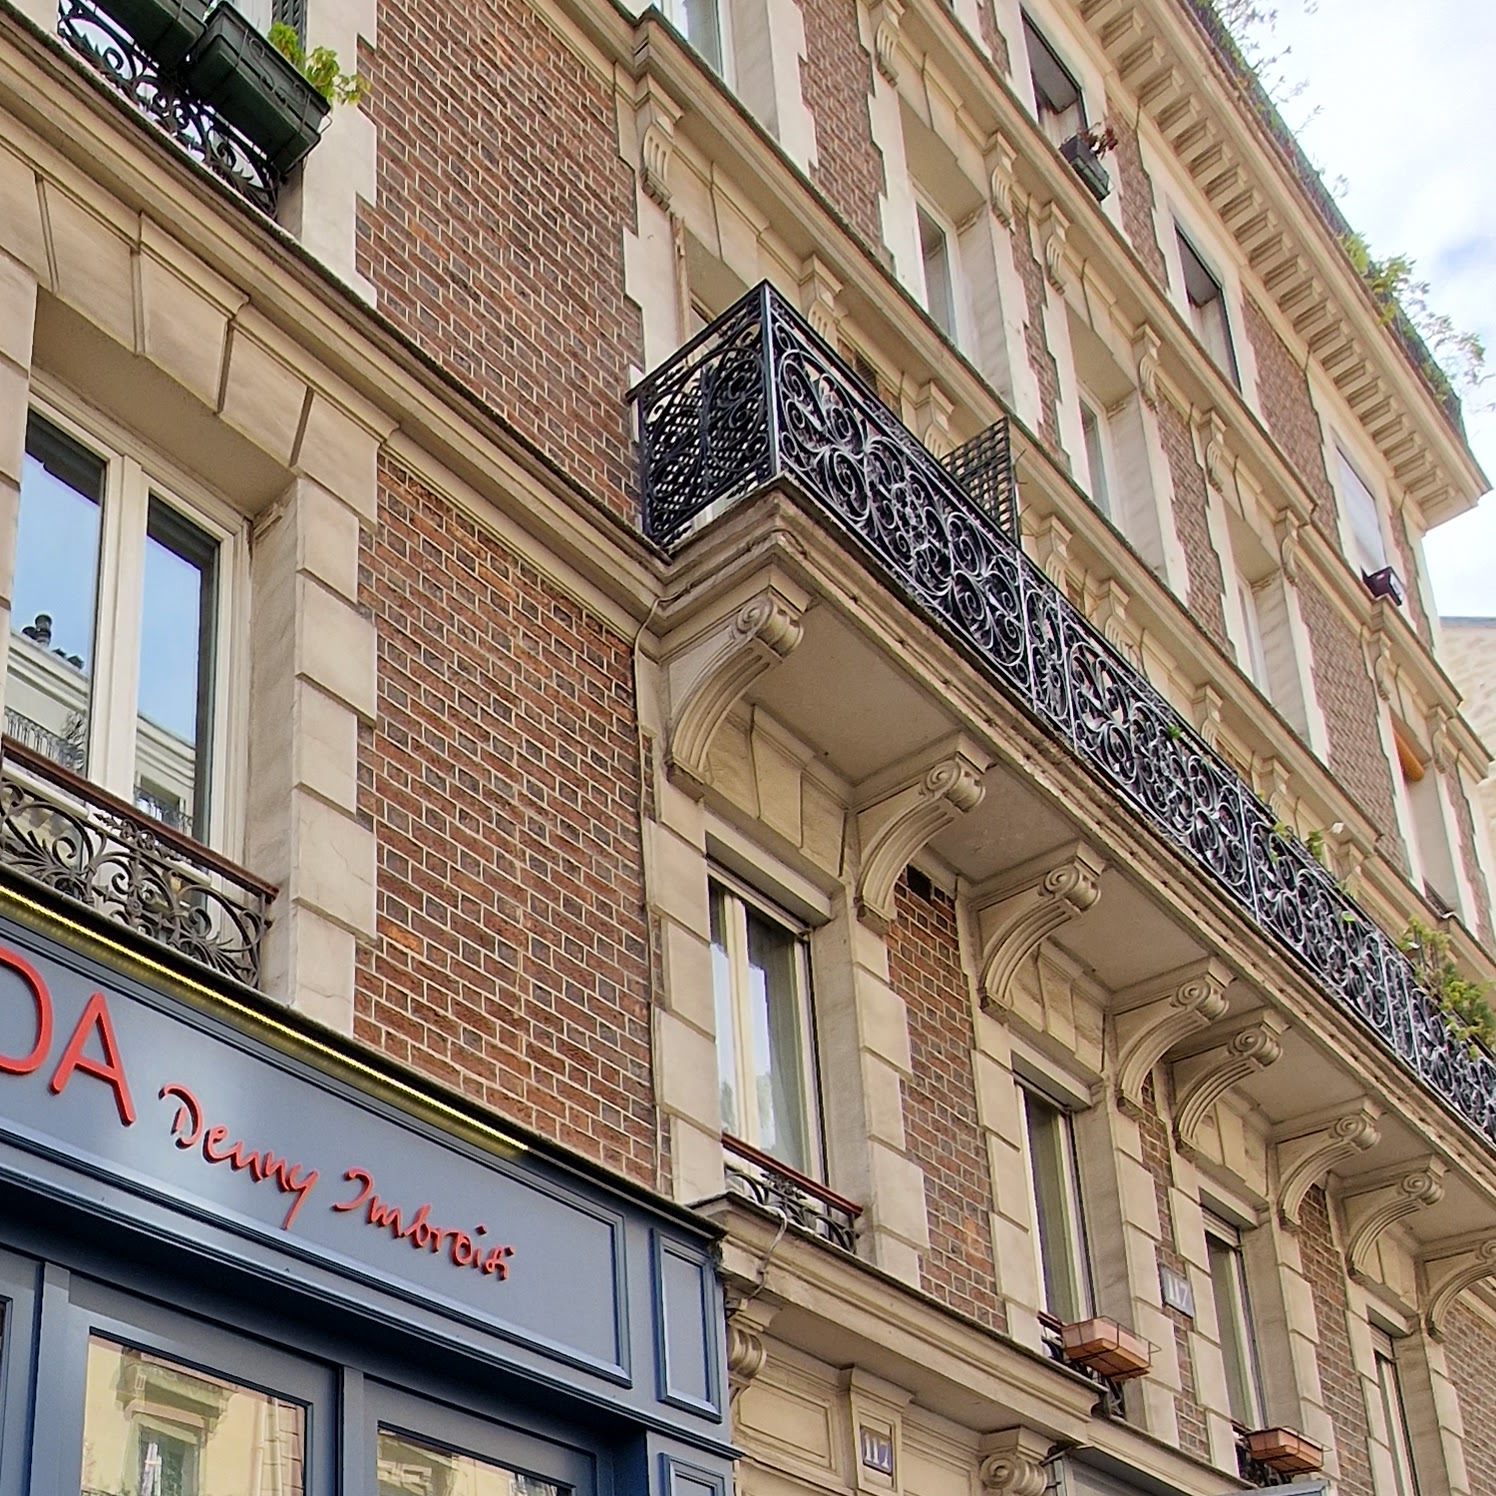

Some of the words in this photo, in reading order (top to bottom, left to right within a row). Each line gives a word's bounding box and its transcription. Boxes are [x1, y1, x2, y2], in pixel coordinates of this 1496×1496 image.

[158, 1083, 320, 1231] Denny
[1167, 1273, 1189, 1307] 117
[864, 1431, 891, 1470] 117
